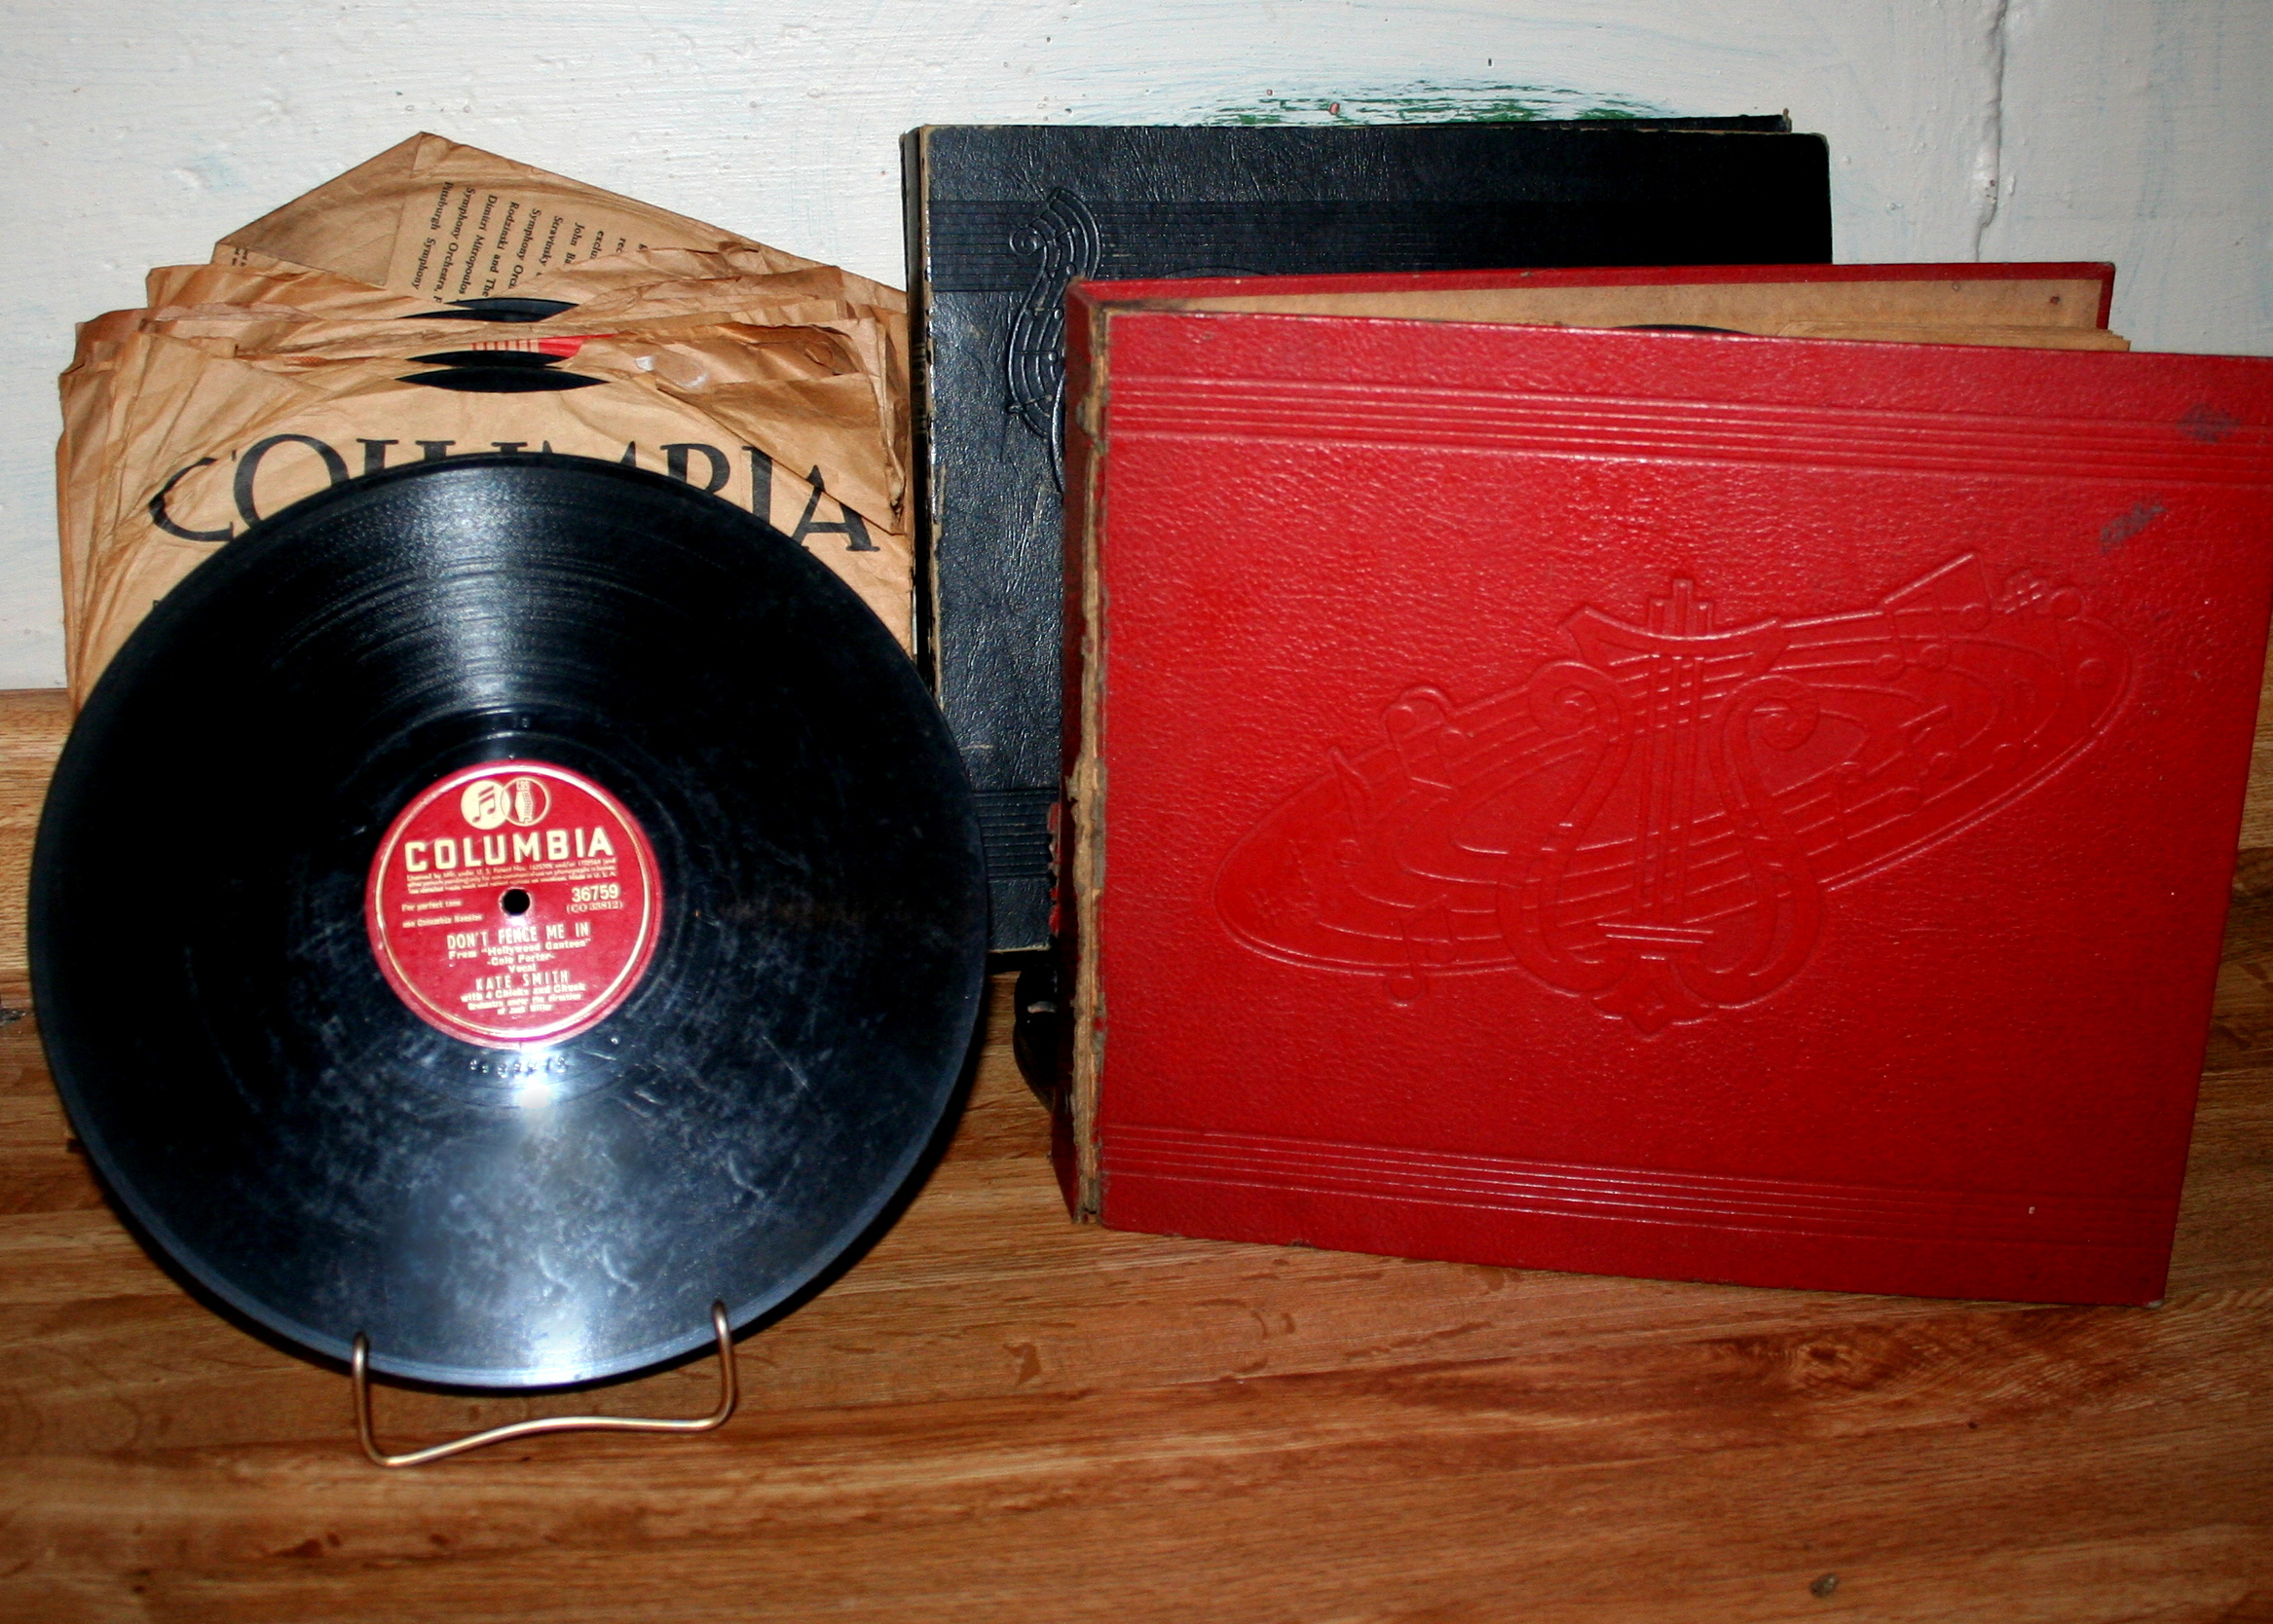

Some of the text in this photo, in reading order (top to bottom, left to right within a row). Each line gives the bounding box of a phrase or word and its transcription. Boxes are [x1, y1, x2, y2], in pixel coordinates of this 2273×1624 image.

[412, 181, 454, 290] Pittsburgh Symphony
[450, 187, 475, 240] Symphony
[517, 208, 541, 261] Symphony
[459, 194, 498, 294] Dimitri Mitropoulos
[482, 201, 520, 297] Rodzinski and The
[540, 215, 563, 267] Stravinsky
[565, 222, 585, 264] John Ba
[433, 241, 459, 292] Orchestra,
[404, 827, 615, 872] COLUMBIA
[571, 883, 619, 903] 36759
[446, 921, 590, 950] DON'T FENCE ME IN
[448, 950, 477, 960] From
[475, 970, 569, 991] KATE SMITH
[507, 964, 537, 973] Vocal
[460, 993, 483, 1002] with
[533, 985, 551, 995] and
